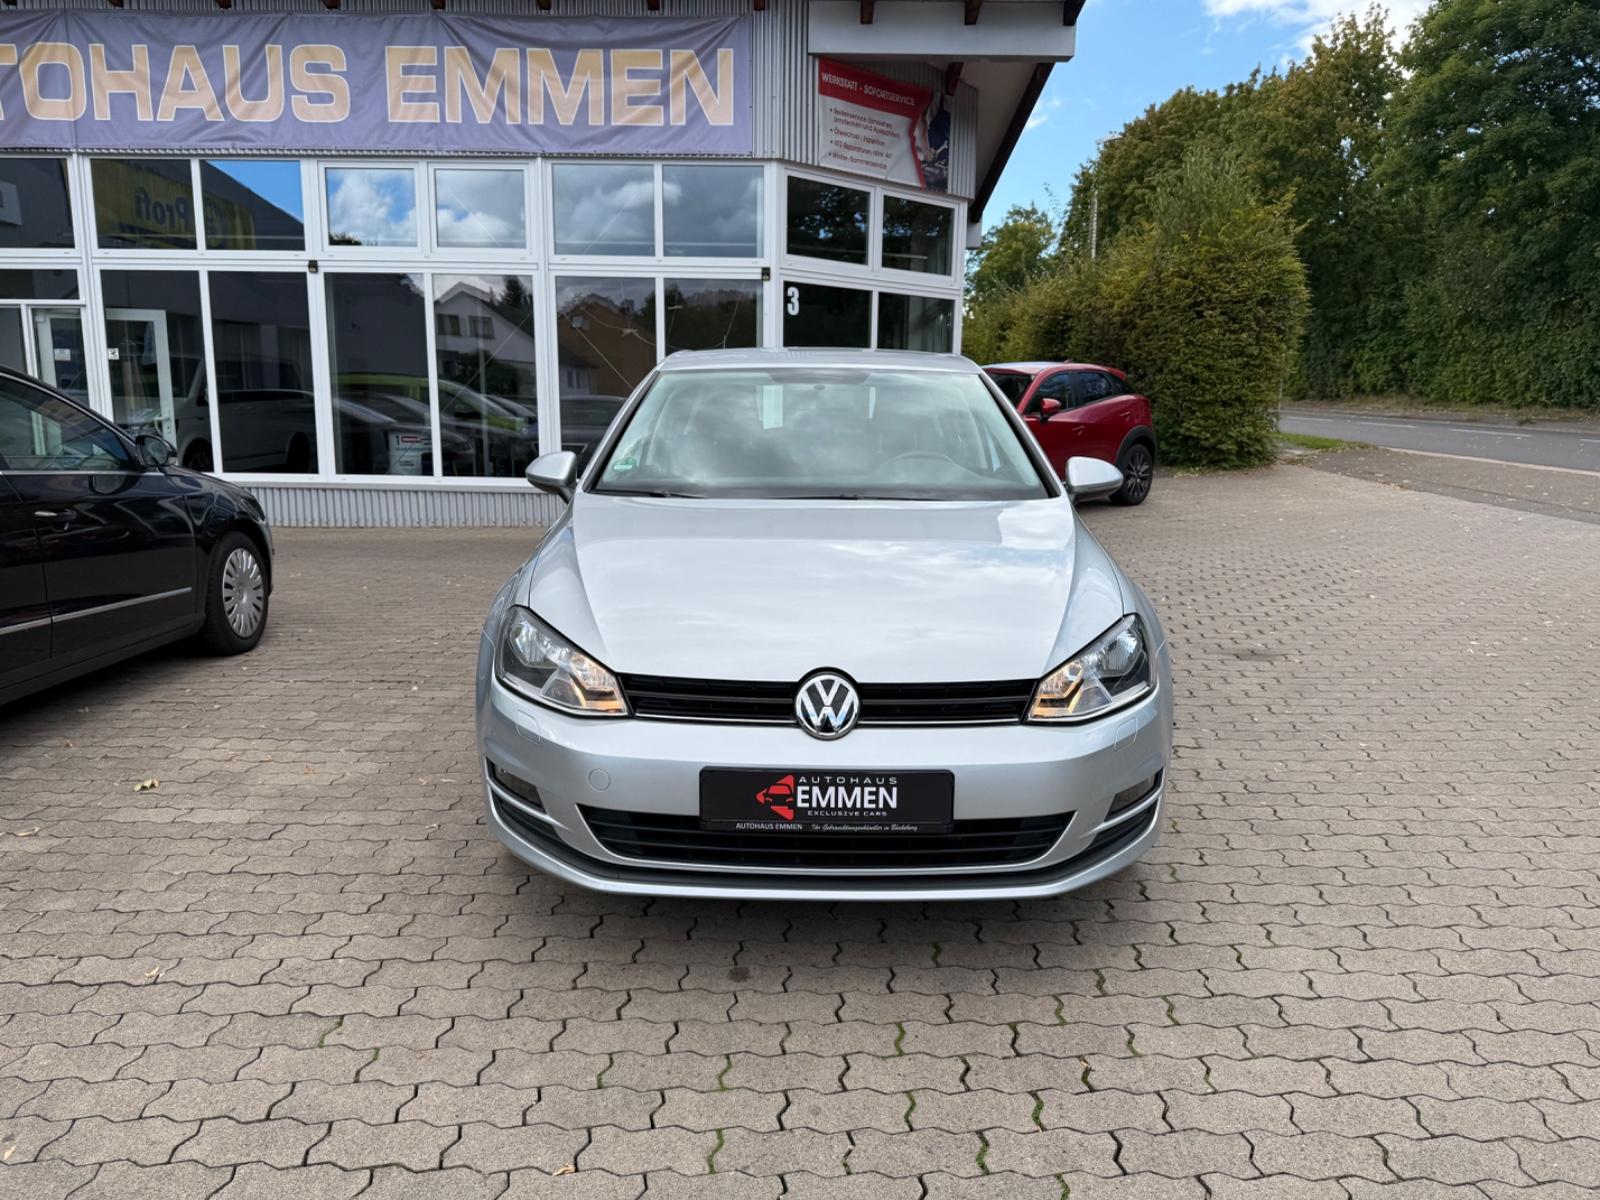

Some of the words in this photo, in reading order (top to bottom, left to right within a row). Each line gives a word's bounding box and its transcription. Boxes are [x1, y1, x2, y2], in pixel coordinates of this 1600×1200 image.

[386, 46, 735, 127] EMMEN
[822, 73, 858, 91] WERKSTATT
[864, 85, 916, 106] SOFORTSERVICE
[787, 286, 800, 316] 3
[798, 776, 898, 784] AUTOHAUS
[796, 785, 898, 809] EMMEN
[735, 822, 774, 830] AUTOHAUS
[775, 823, 803, 831] EMMEN
